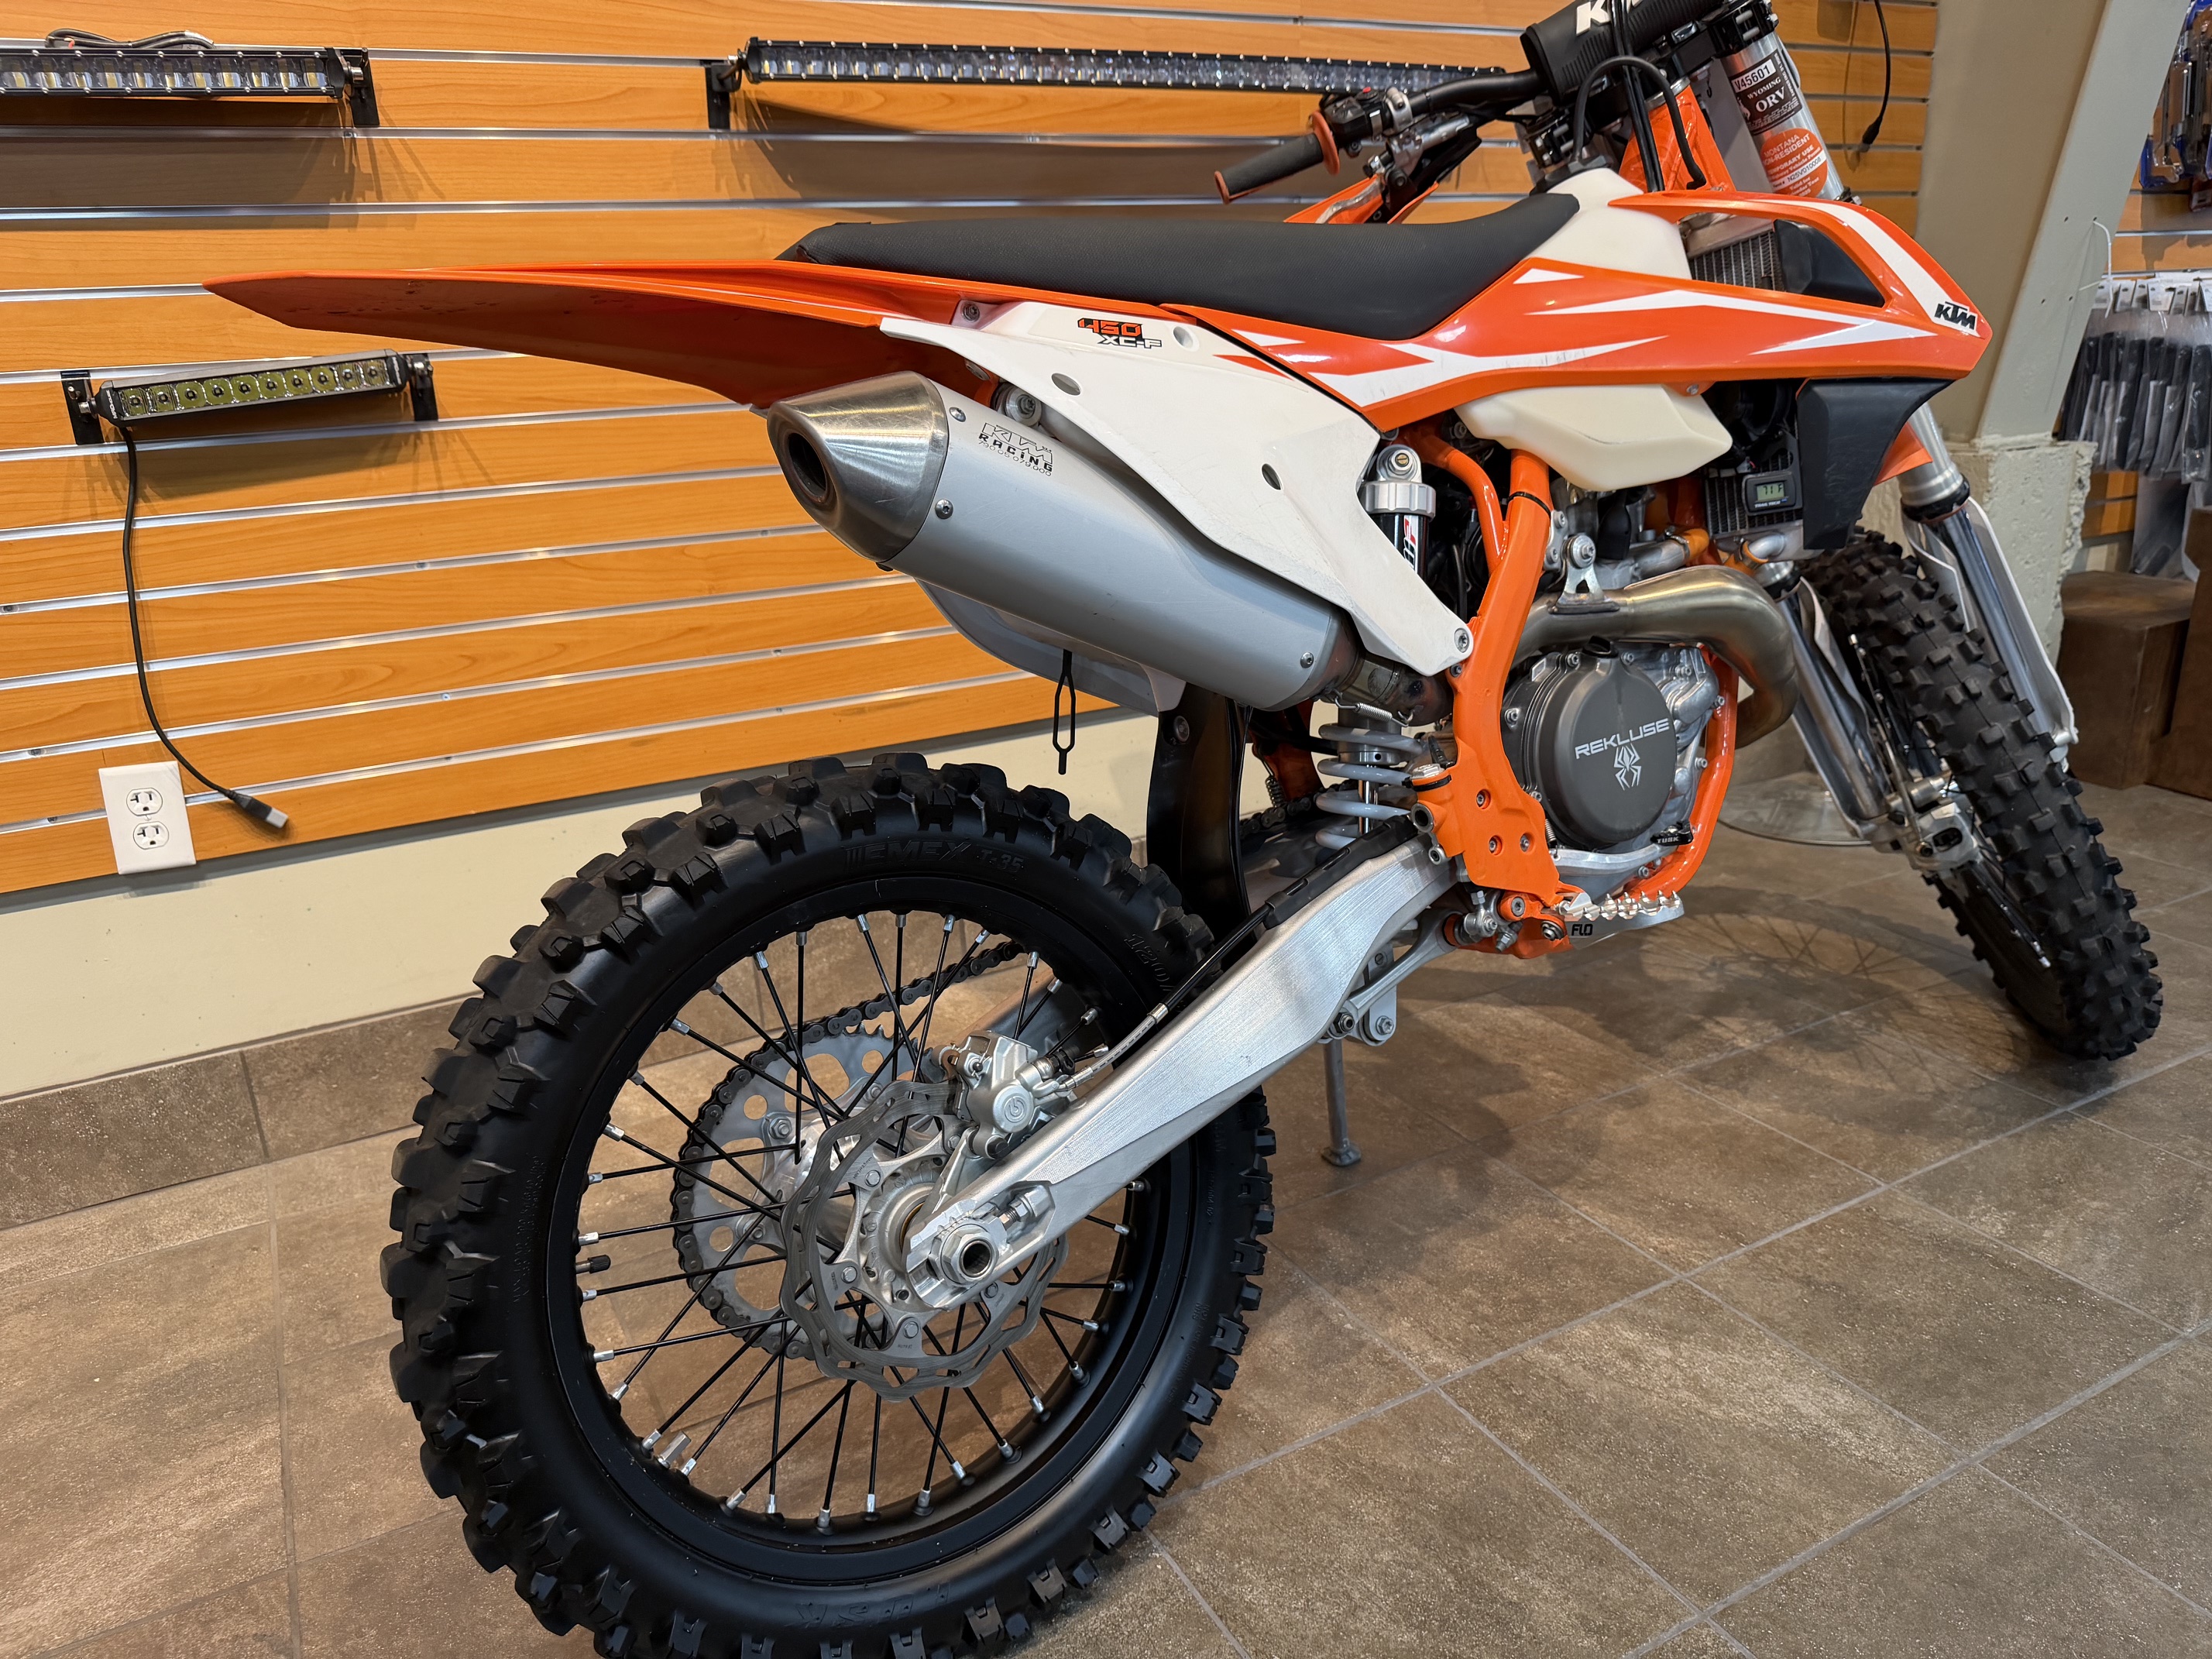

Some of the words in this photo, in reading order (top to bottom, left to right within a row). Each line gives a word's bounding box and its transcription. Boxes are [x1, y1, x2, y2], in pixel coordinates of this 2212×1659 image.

[1735, 64, 1771, 91] V45601
[1747, 77, 1781, 99] WYOMING
[1756, 86, 1784, 112] ORV
[1764, 134, 1800, 158] MONTANA
[1077, 318, 1142, 336] 450
[1934, 301, 1976, 330] KTM
[1097, 334, 1162, 349] XC-F
[982, 423, 1053, 465] KTM
[998, 449, 1010, 458] 05
[1575, 718, 1670, 759] REKLUSE
[1657, 836, 1679, 844] TUSK
[1571, 924, 1593, 936] FLO
